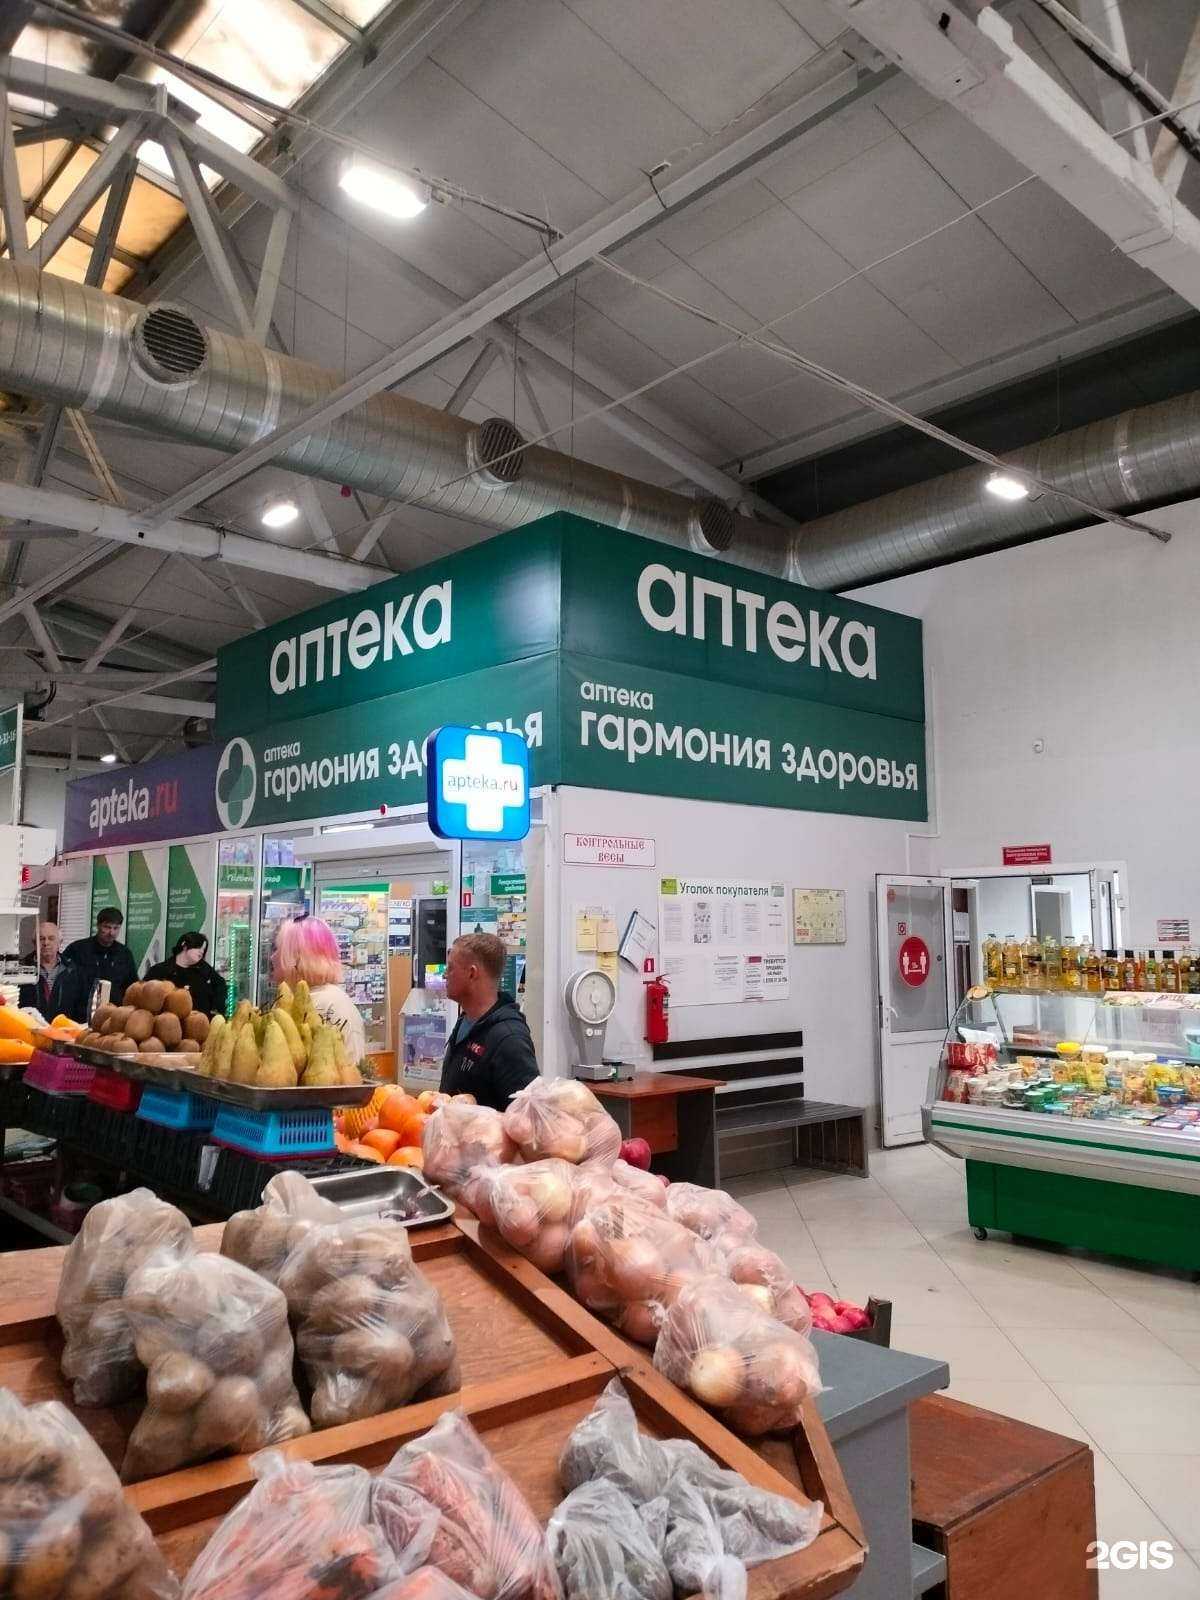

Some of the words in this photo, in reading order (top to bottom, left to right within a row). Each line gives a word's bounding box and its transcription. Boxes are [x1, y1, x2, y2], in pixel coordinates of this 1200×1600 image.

[269, 579, 452, 695] аптека
[637, 563, 877, 681] аптека
[580, 680, 654, 710] аптека
[263, 741, 301, 763] аптека
[580, 710, 771, 770] гармония
[781, 742, 919, 791] здоровья
[263, 747, 380, 803] гармония
[447, 774, 518, 793] apteka.ru
[89, 778, 178, 838] apteka.ru
[576, 836, 645, 850] КОНТРОЛЬНЫЕ
[598, 852, 625, 863] ВЕСЫ
[680, 882, 713, 895] Уголок
[716, 885, 769, 898] покупателя
